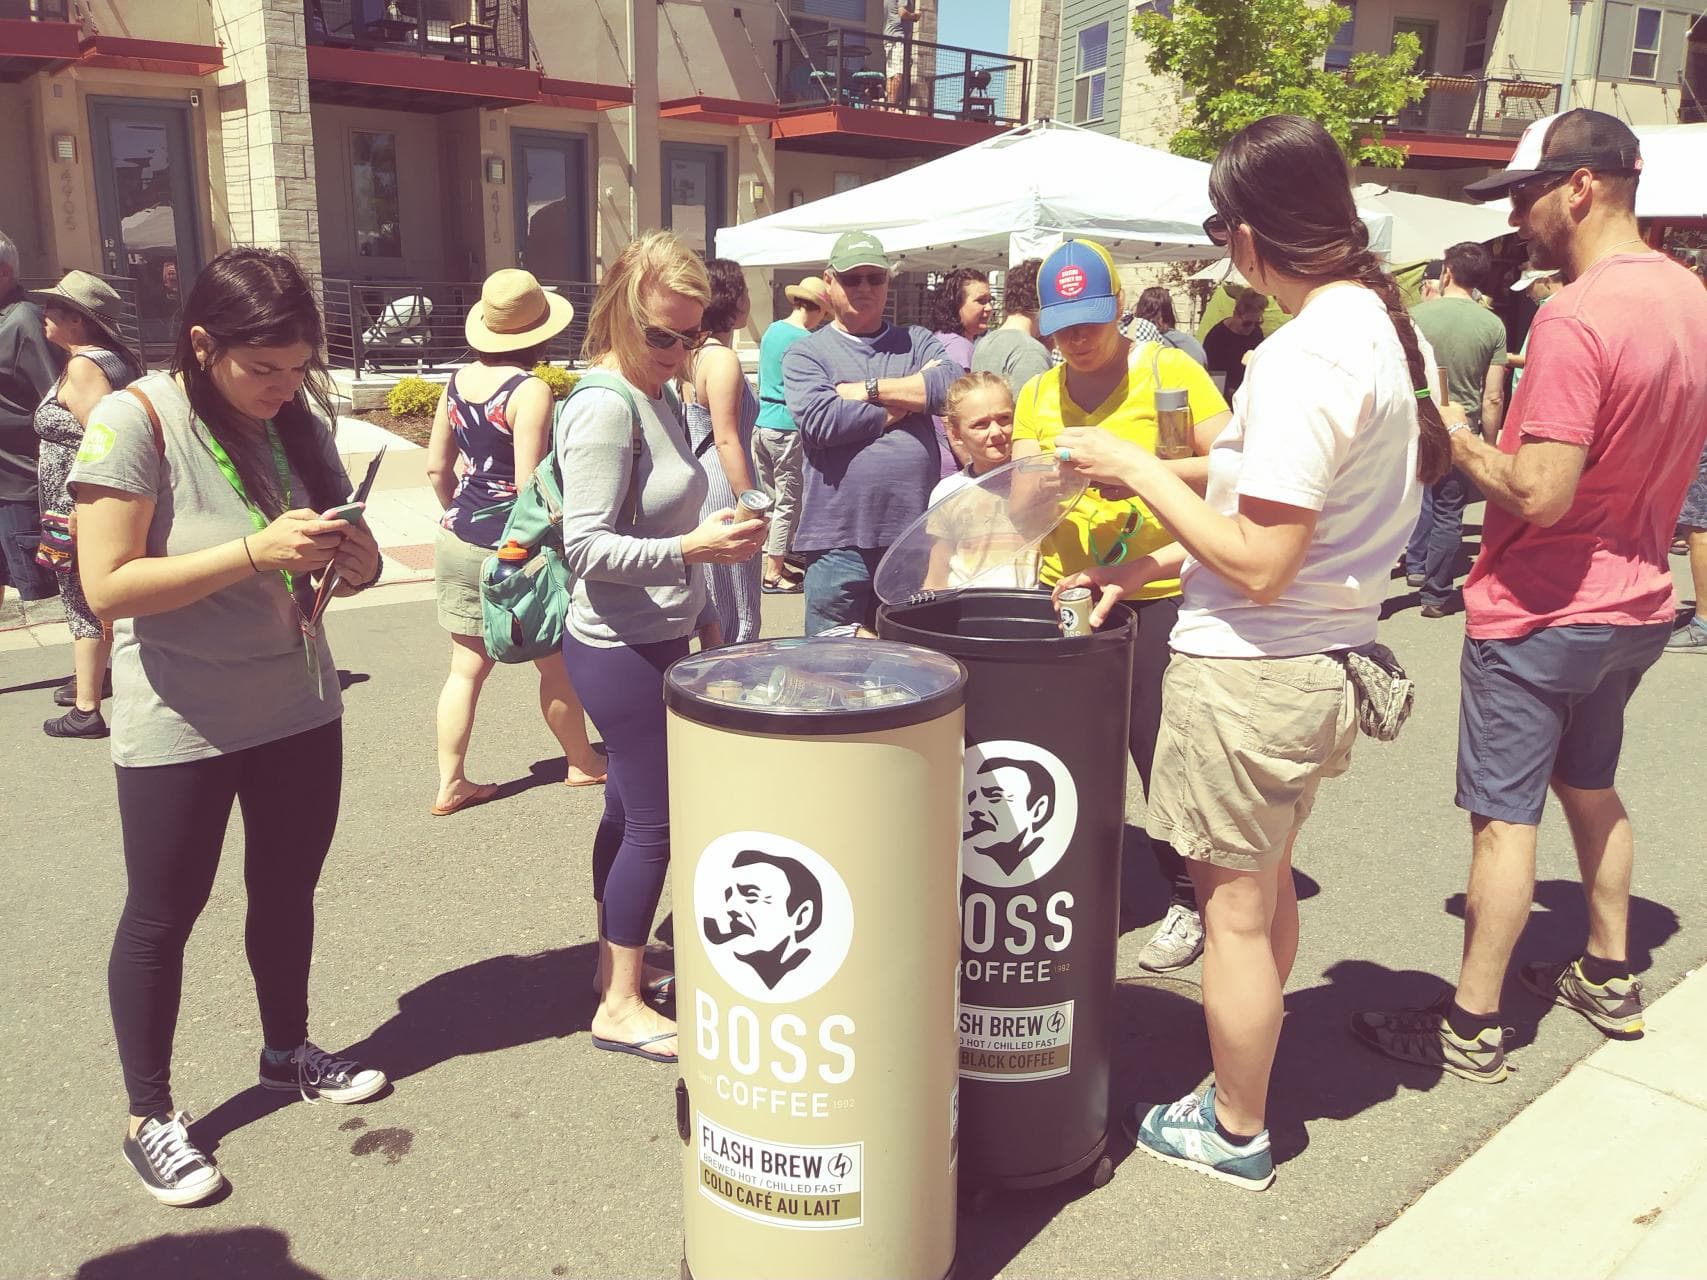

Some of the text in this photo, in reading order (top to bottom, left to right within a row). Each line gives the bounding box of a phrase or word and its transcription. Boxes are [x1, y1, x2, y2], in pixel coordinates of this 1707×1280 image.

[964, 891, 1074, 955] OSS
[961, 960, 1051, 983] OFFEE
[695, 988, 856, 1084] BOSS
[967, 1039, 985, 1048] HOT
[994, 1041, 1033, 1050] CHILLED
[1035, 1038, 1058, 1048] FAST
[990, 1015, 1044, 1038] BREW
[962, 1051, 1055, 1069] BLACK COFFEE
[716, 1074, 829, 1117] COFFEE
[703, 1126, 822, 1179] FLASH BREW
[703, 1153, 736, 1177] BREWED
[739, 1173, 757, 1186] HOT
[766, 1180, 812, 1194] CHILLED
[815, 1184, 843, 1193] FAST
[704, 1169, 840, 1216] COLD CAFÉ AU LAIT
